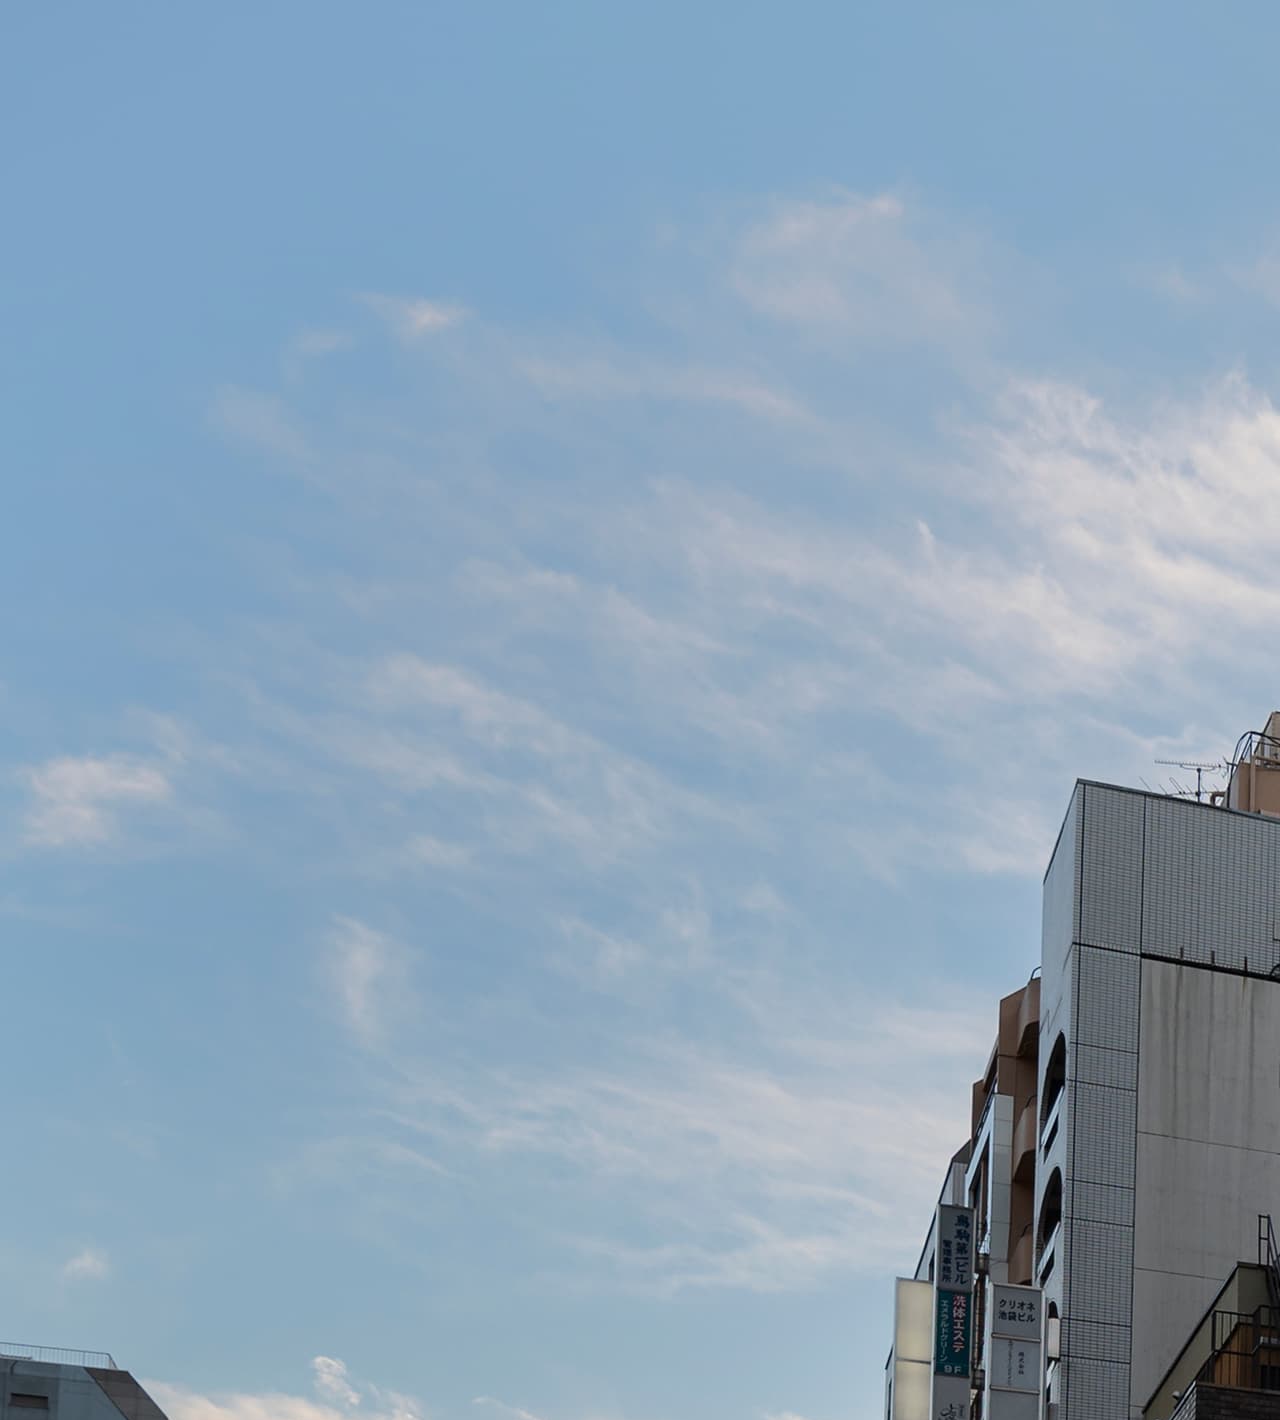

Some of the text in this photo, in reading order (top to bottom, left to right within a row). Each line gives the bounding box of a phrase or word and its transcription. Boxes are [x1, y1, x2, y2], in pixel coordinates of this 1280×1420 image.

[999, 1299, 1036, 1311] クリオネ
[998, 1311, 1036, 1323] 池袋ビル
[953, 1294, 967, 1354] 洗体エステ
